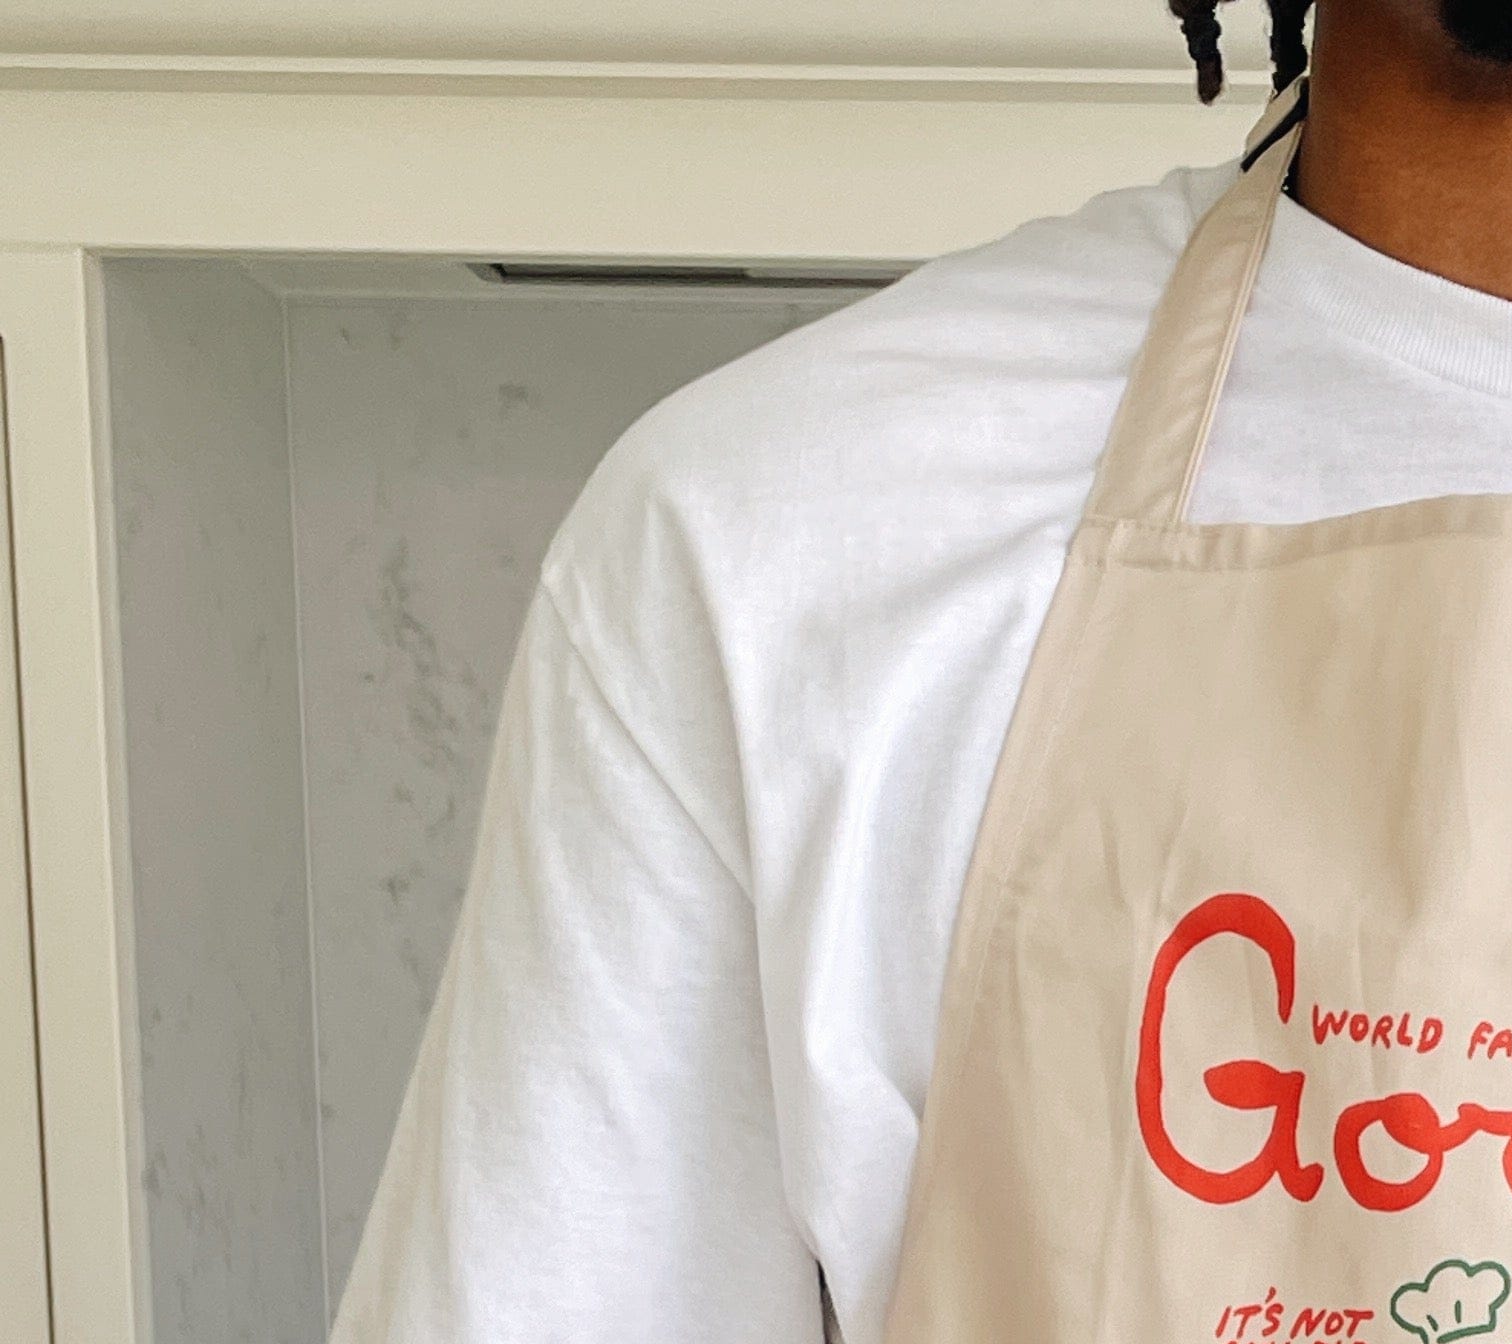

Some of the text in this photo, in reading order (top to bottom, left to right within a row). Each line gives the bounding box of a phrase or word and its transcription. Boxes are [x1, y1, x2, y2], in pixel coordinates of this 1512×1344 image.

[1311, 1005, 1444, 1054] WORLD
[1214, 1286, 1375, 1340] IT'S NOT
